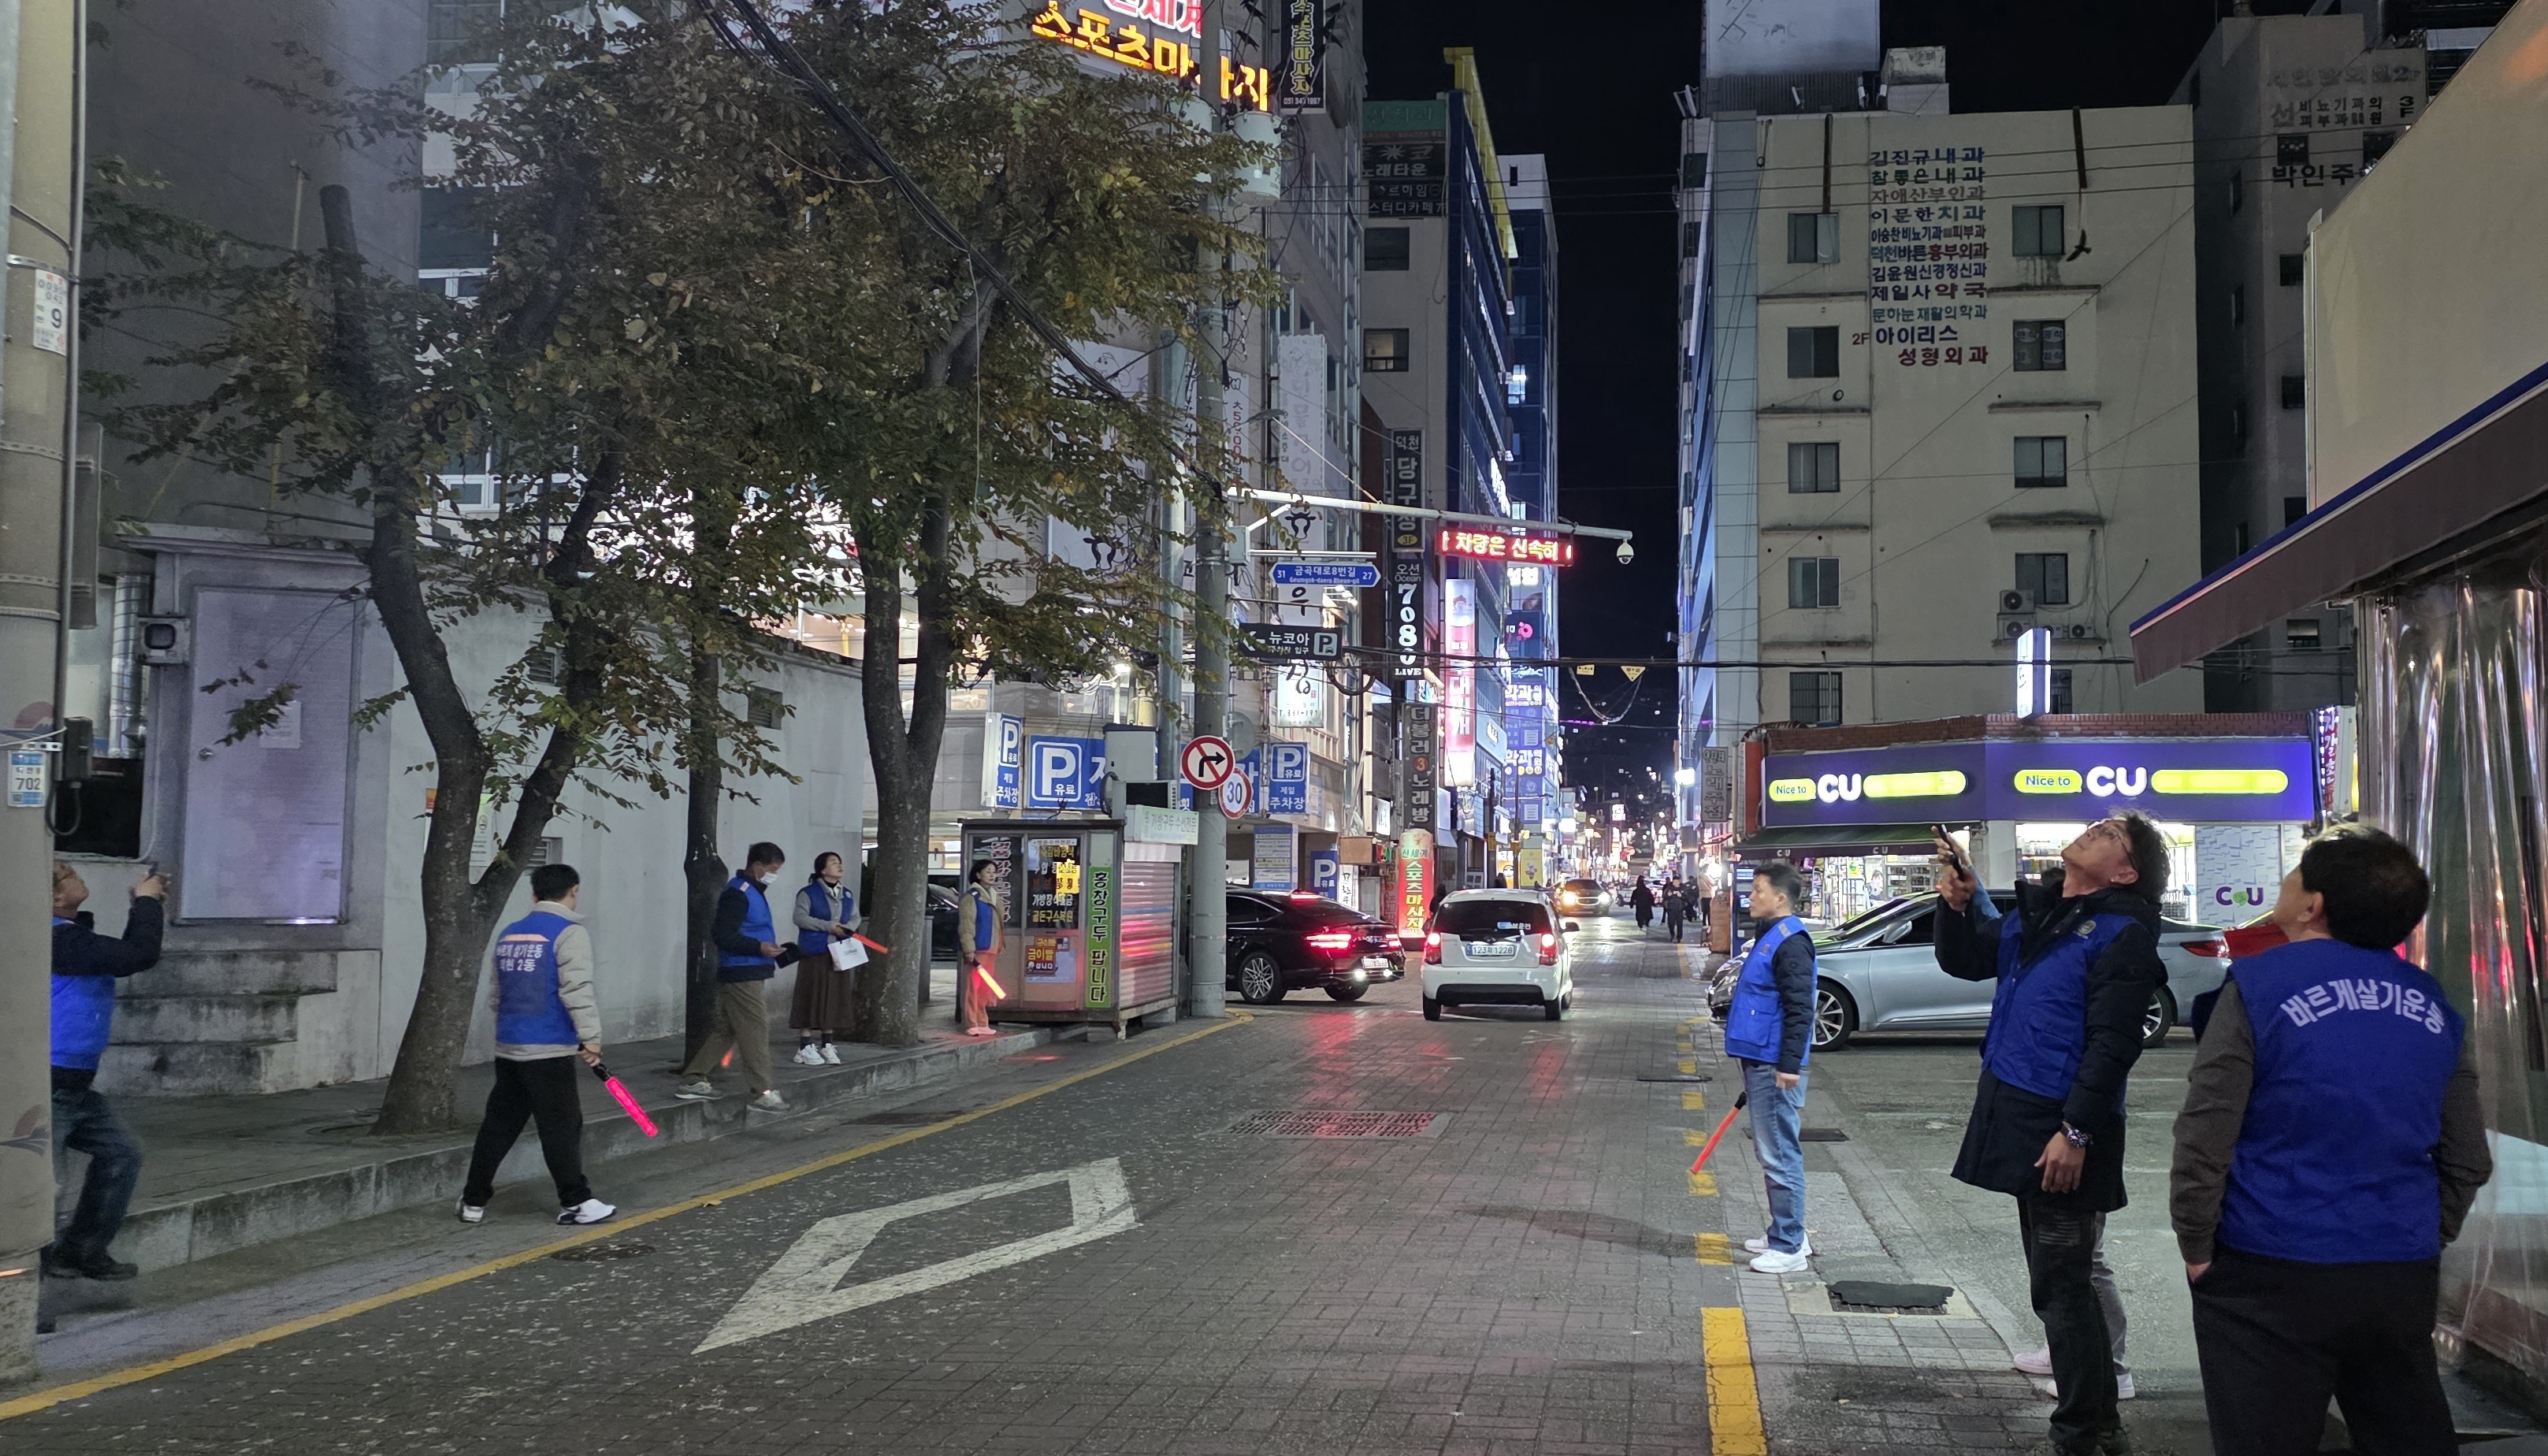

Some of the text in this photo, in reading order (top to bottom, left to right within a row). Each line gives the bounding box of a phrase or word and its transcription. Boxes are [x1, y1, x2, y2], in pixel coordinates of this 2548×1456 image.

[1369, 202, 1433, 214] 스터디카페
[51, 308, 62, 329] 9
[1852, 324, 1959, 345] 2F 아이리스
[1898, 346, 1989, 367] 성형외과
[1395, 436, 1419, 452] 덕천
[1397, 457, 1417, 531] 당구장
[1402, 536, 1414, 545] 3F
[1455, 532, 1559, 562] 차량은 신속히
[1276, 566, 1372, 581] 31 금곡대로8번길 27
[1395, 563, 1420, 576] 오션
[1269, 632, 1309, 645] 뉴코아
[1294, 646, 1309, 655] 입구
[1395, 667, 1421, 676] LIVE
[1285, 770, 1302, 778] 유료
[2026, 766, 2147, 797] Nice to CU
[16, 777, 41, 790] 702
[1054, 784, 1075, 796] 유료
[1280, 786, 1295, 795] 제일
[1776, 786, 1796, 794] Nice
[1817, 774, 1862, 803] CU
[996, 786, 1019, 808] 주차장
[1227, 782, 1242, 804] 30
[1411, 774, 1431, 823] 노래방
[1270, 797, 1305, 810] 주차장
[1406, 860, 1425, 929] 스포츠마사지
[2216, 886, 2264, 906] CU
[1092, 871, 1109, 942] 홍창구두
[1027, 948, 1054, 961] 금이빨
[517, 958, 537, 972] 2동
[1091, 949, 1108, 1002] 팝니다
[2280, 979, 2446, 1034] 바르게살기운동
